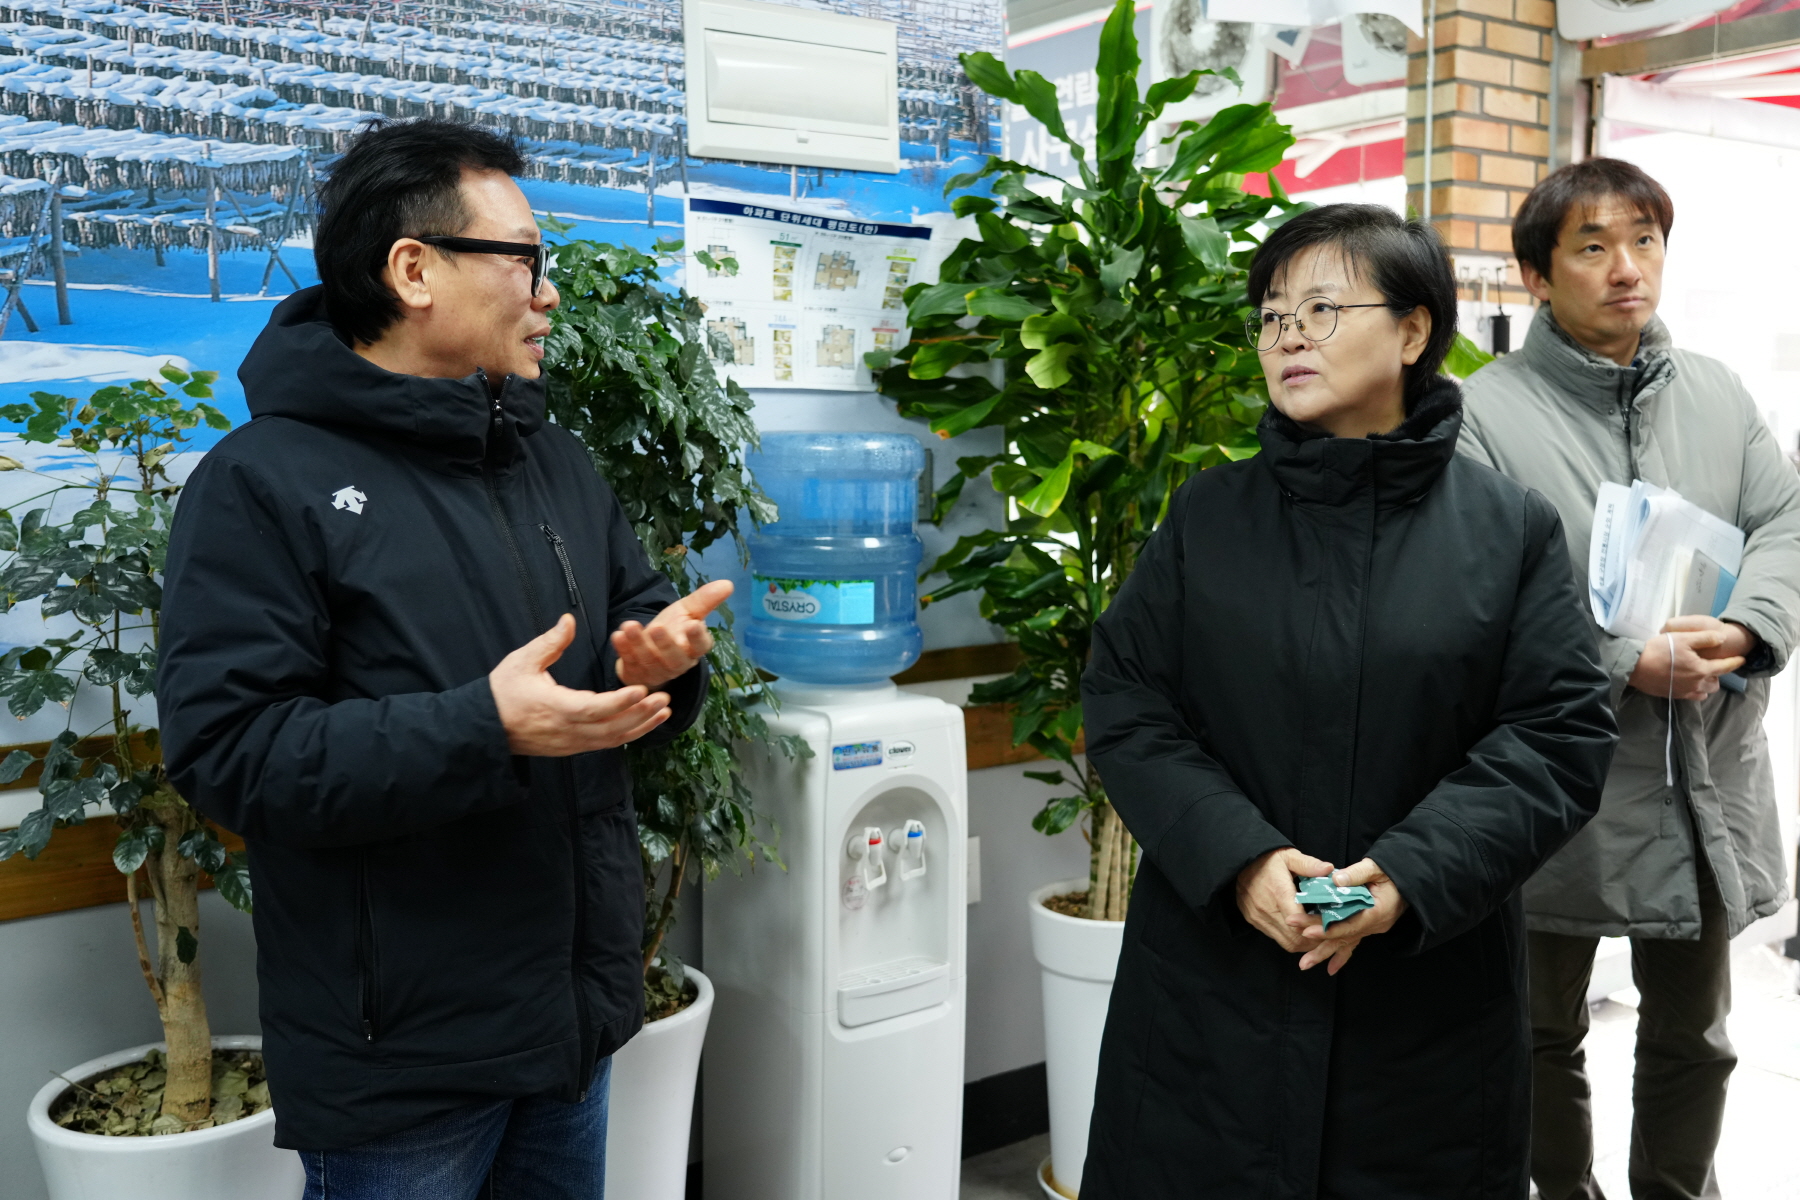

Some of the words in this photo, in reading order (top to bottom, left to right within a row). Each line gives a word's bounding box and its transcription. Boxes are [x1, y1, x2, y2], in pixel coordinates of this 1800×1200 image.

[743, 206, 775, 219] 아파트
[780, 212, 823, 227] 단위세대
[827, 219, 879, 235] 평면도(안)
[765, 598, 816, 614] CRYSTAL
